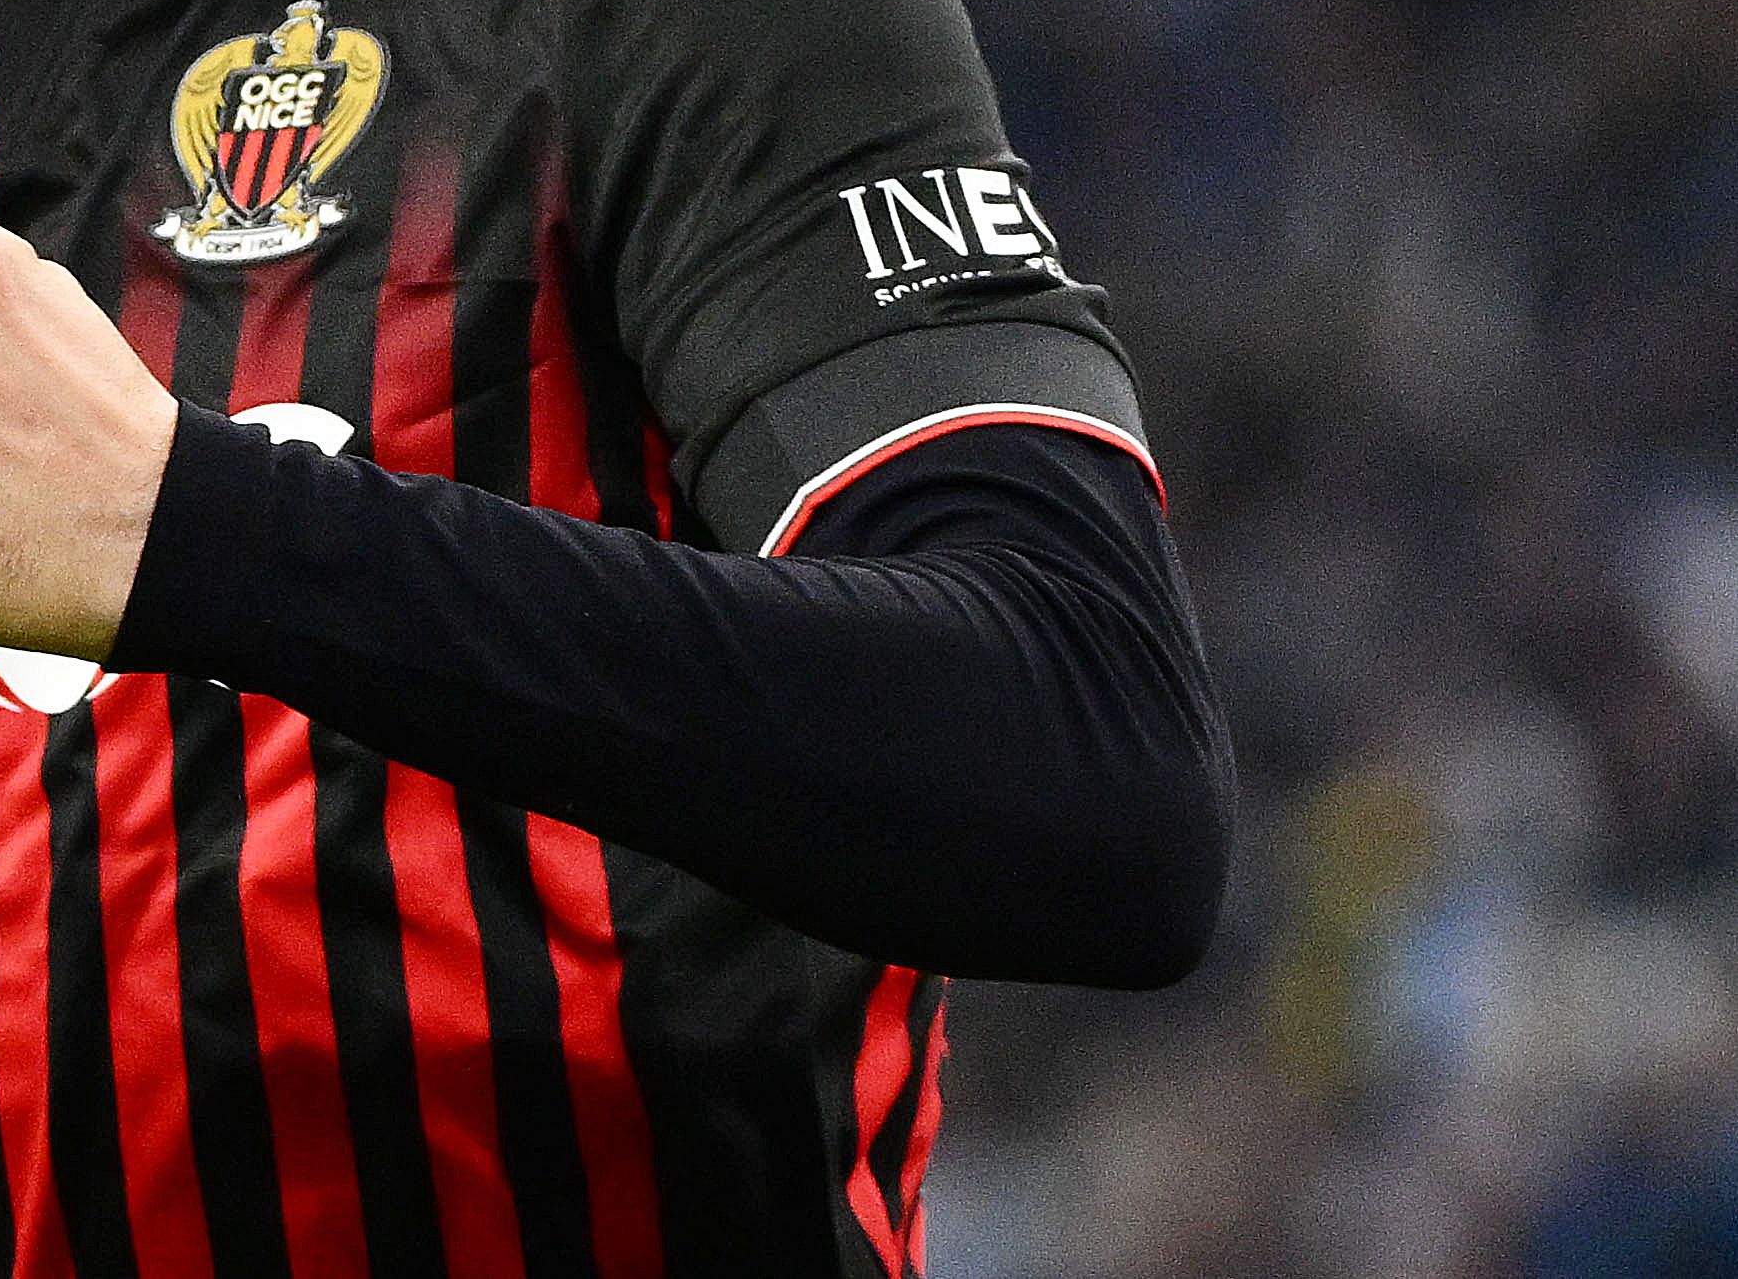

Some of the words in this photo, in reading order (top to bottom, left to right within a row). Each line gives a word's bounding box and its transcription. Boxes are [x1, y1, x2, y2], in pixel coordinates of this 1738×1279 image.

[241, 71, 325, 104] OGC
[233, 98, 318, 132] NICE
[838, 167, 1058, 279] INE
